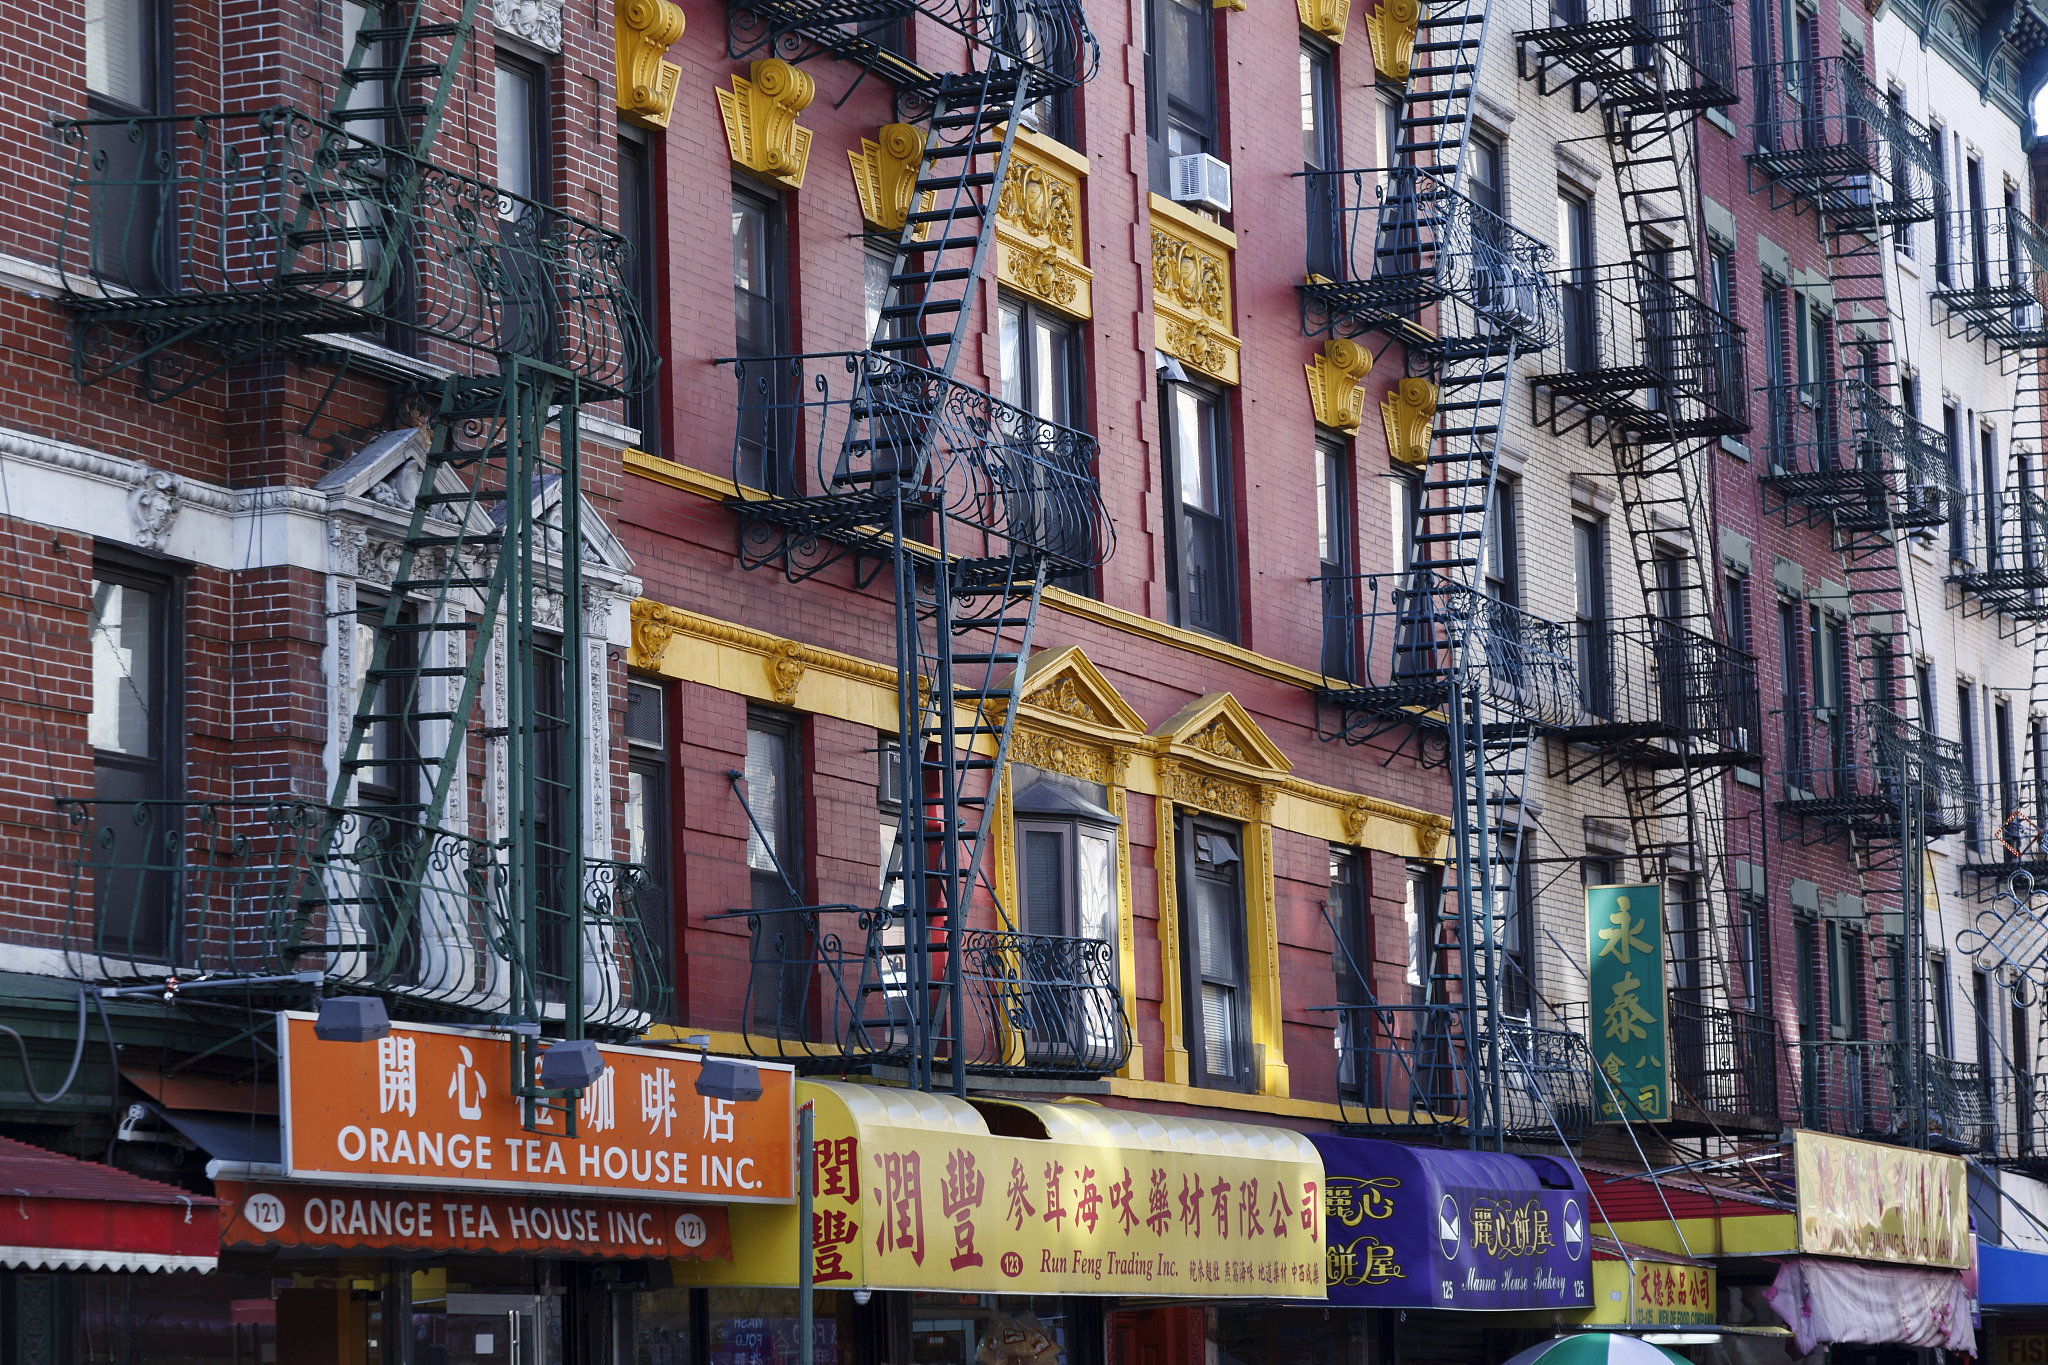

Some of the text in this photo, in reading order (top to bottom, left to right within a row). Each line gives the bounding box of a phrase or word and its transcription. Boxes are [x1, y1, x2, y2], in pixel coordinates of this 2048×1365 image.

[1597, 895, 1658, 1043] 永泰
[1601, 1051, 1627, 1116] 食品
[337, 1125, 763, 1190] ORANGE TEA HOUSE INC.
[253, 1197, 701, 1246] 121 ORANGE TEA HOUSE INC. 121
[873, 1148, 985, 1272] 潤豐
[1005, 1249, 1179, 1281] 123 Run Feng Trading Inc.
[1441, 1267, 1585, 1300] 125 Manna House Bakery 125
